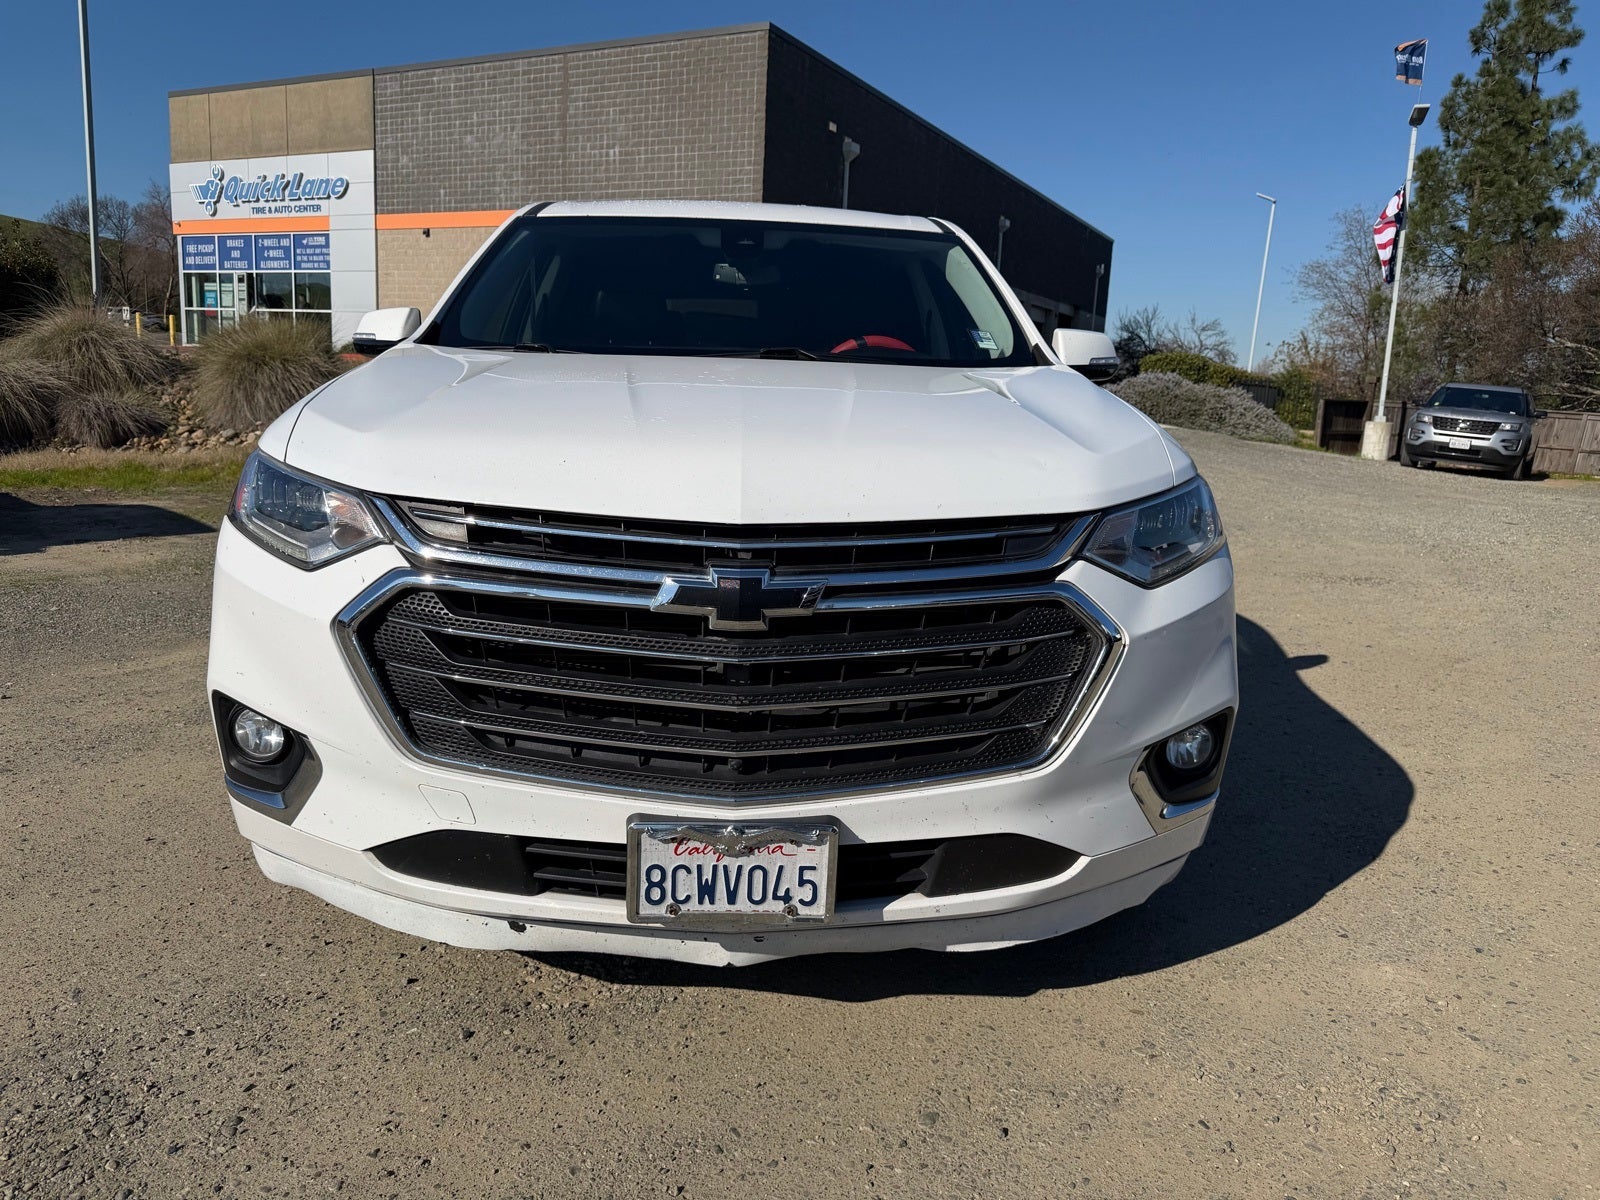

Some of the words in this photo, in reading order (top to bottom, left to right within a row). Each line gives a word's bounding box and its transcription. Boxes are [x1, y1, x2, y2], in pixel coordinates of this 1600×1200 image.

[223, 174, 288, 204] Quick
[287, 172, 347, 199] Lane
[252, 206, 267, 215] TIRE
[268, 206, 273, 214] &
[274, 205, 292, 214] AUTO
[294, 204, 322, 213] CENTER
[226, 239, 244, 248] BRAKES
[280, 238, 290, 247] AND
[186, 244, 197, 253] FREE
[198, 244, 214, 253] PICKUP
[231, 250, 240, 258] AND
[185, 256, 194, 265] AND
[195, 256, 216, 265] DELIVERY
[224, 260, 248, 269] BATTERIES
[260, 260, 289, 269] ALIGNMENTS
[644, 863, 818, 907] 8CWV045
